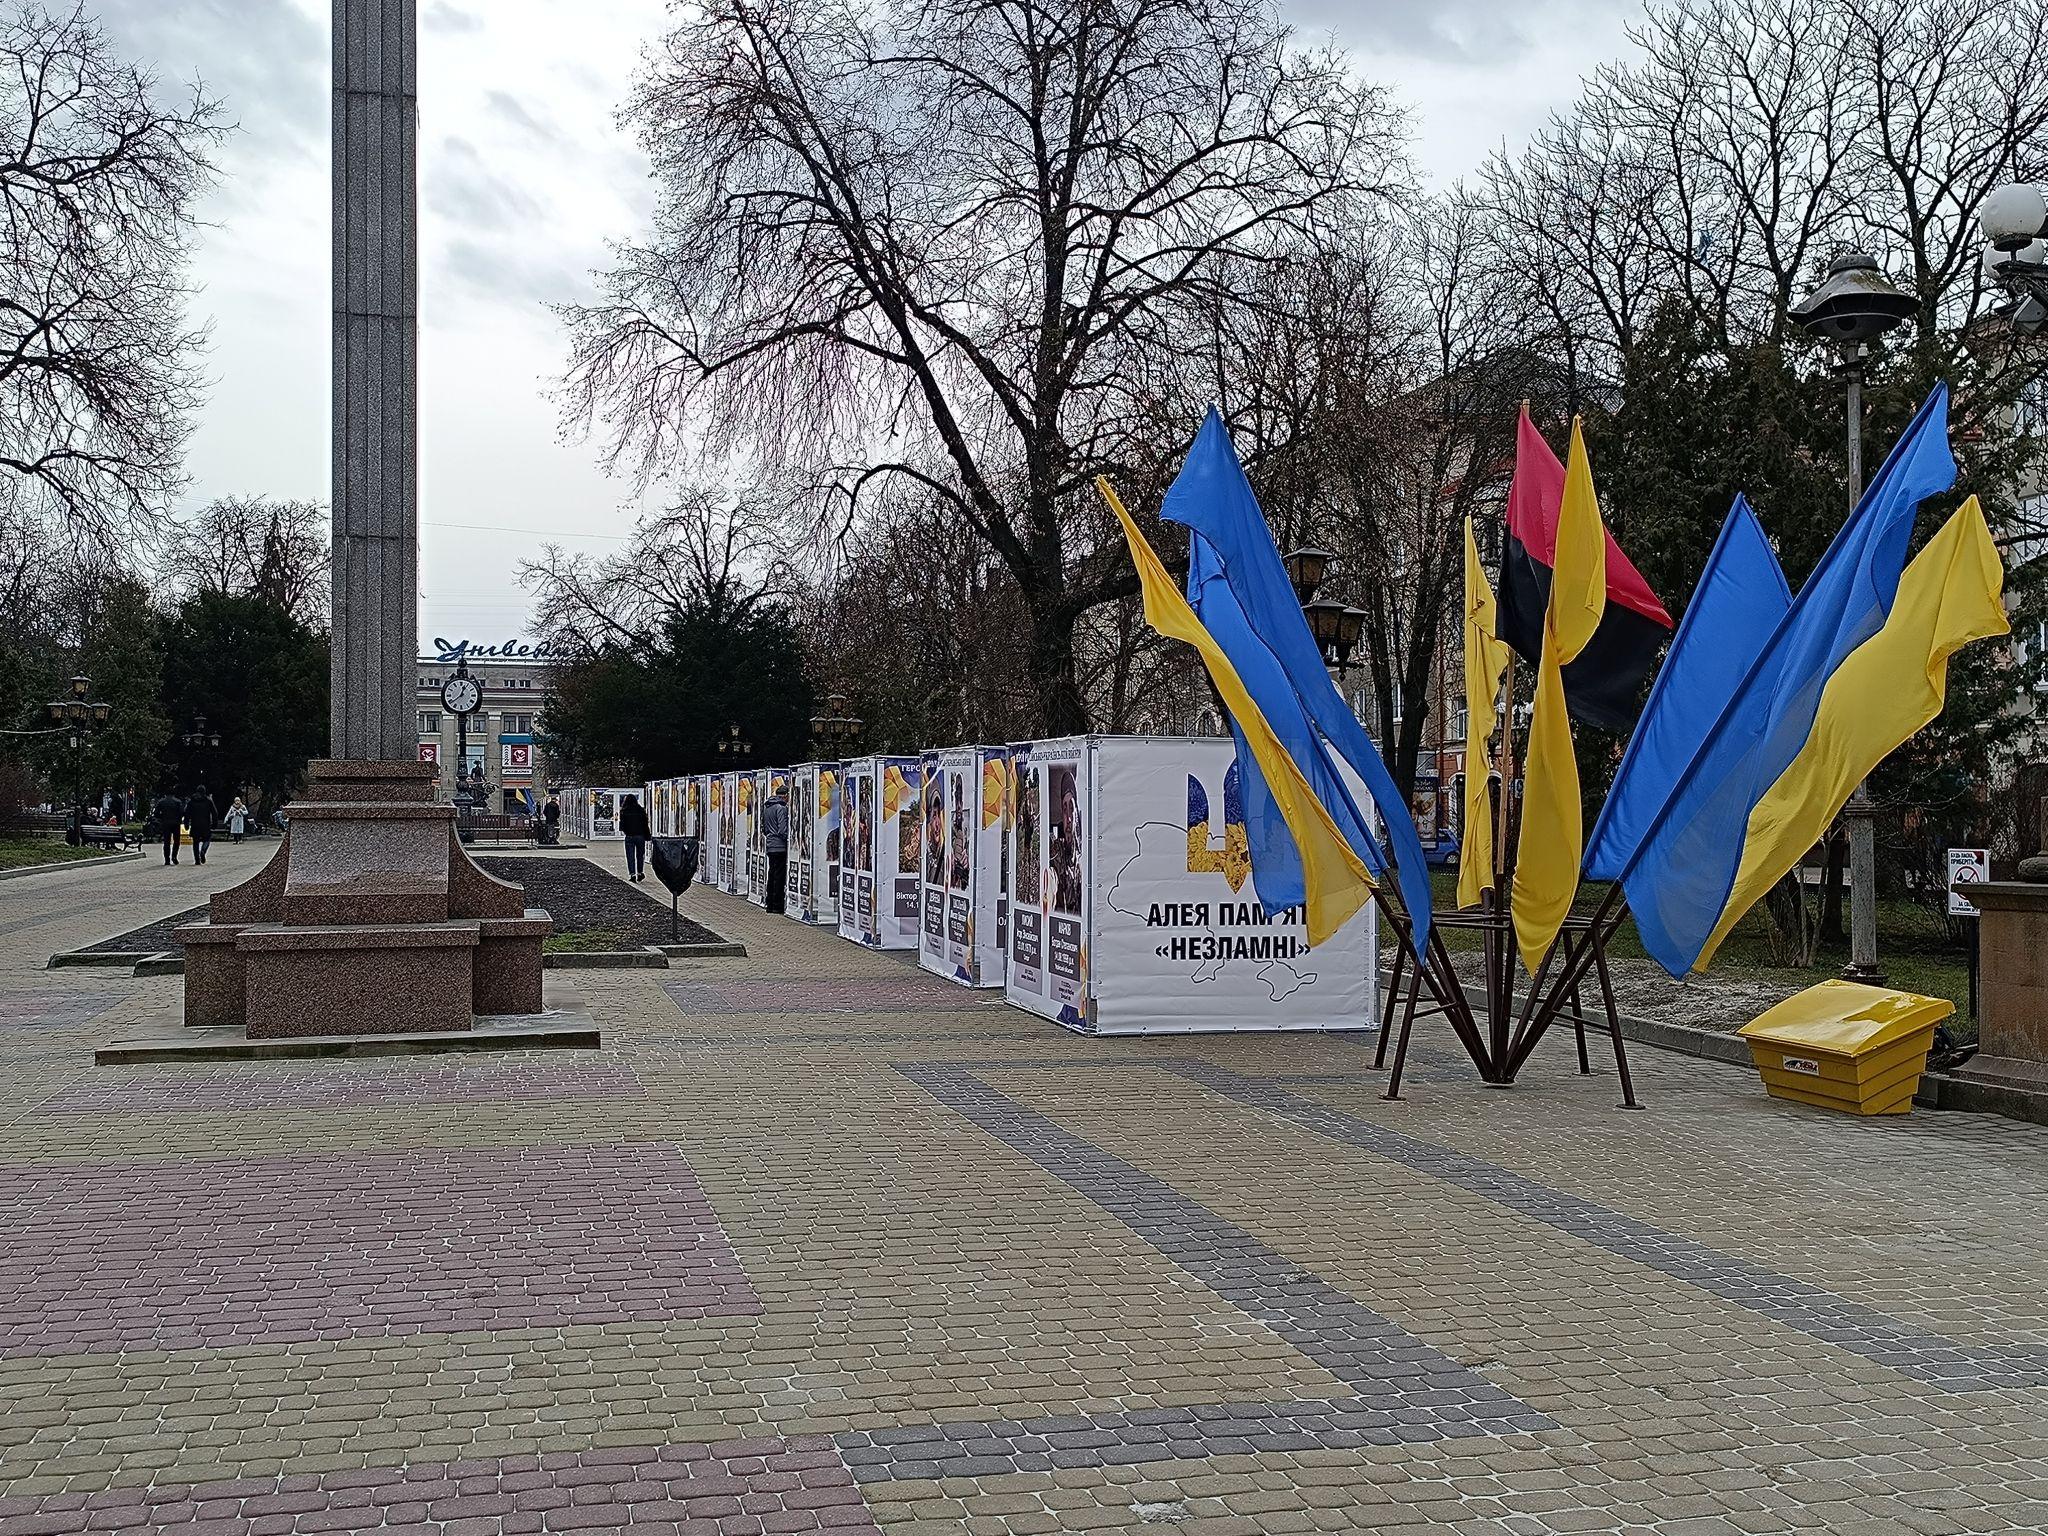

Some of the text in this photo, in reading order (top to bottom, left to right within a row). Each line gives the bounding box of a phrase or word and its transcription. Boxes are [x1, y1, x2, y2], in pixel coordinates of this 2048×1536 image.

[434, 638, 577, 662] Універ
[901, 764, 920, 772] ГЕРО
[896, 891, 918, 901] Віктор
[905, 901, 919, 909] 14.1
[1147, 903, 1209, 927] АЛЕЯ
[1155, 936, 1311, 960] «НЕЗЛАМНІ»
